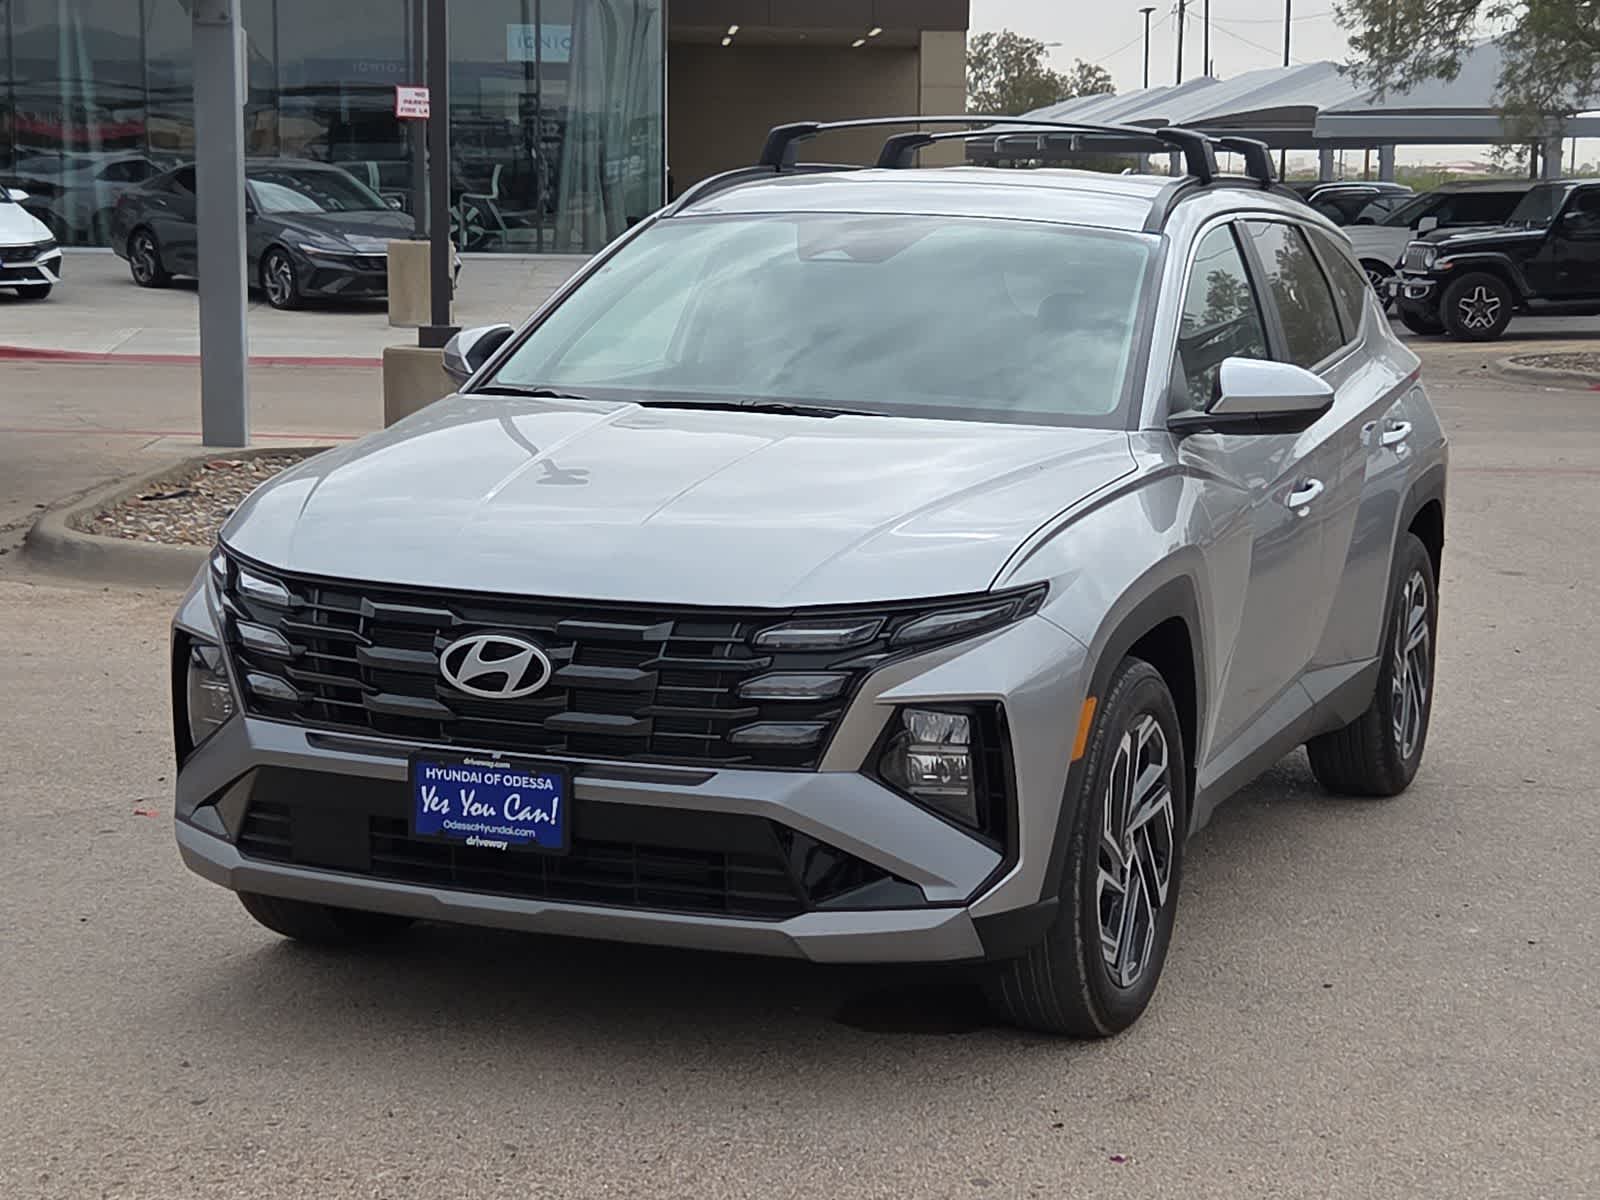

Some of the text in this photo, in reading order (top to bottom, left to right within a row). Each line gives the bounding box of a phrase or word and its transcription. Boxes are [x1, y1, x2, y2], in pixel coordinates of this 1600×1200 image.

[426, 768, 553, 791] HYUNDAI OF ODESSA
[421, 785, 559, 825] Yes You Can!
[443, 819, 536, 838] OdessaHyundai.com
[466, 835, 508, 851] driveway
